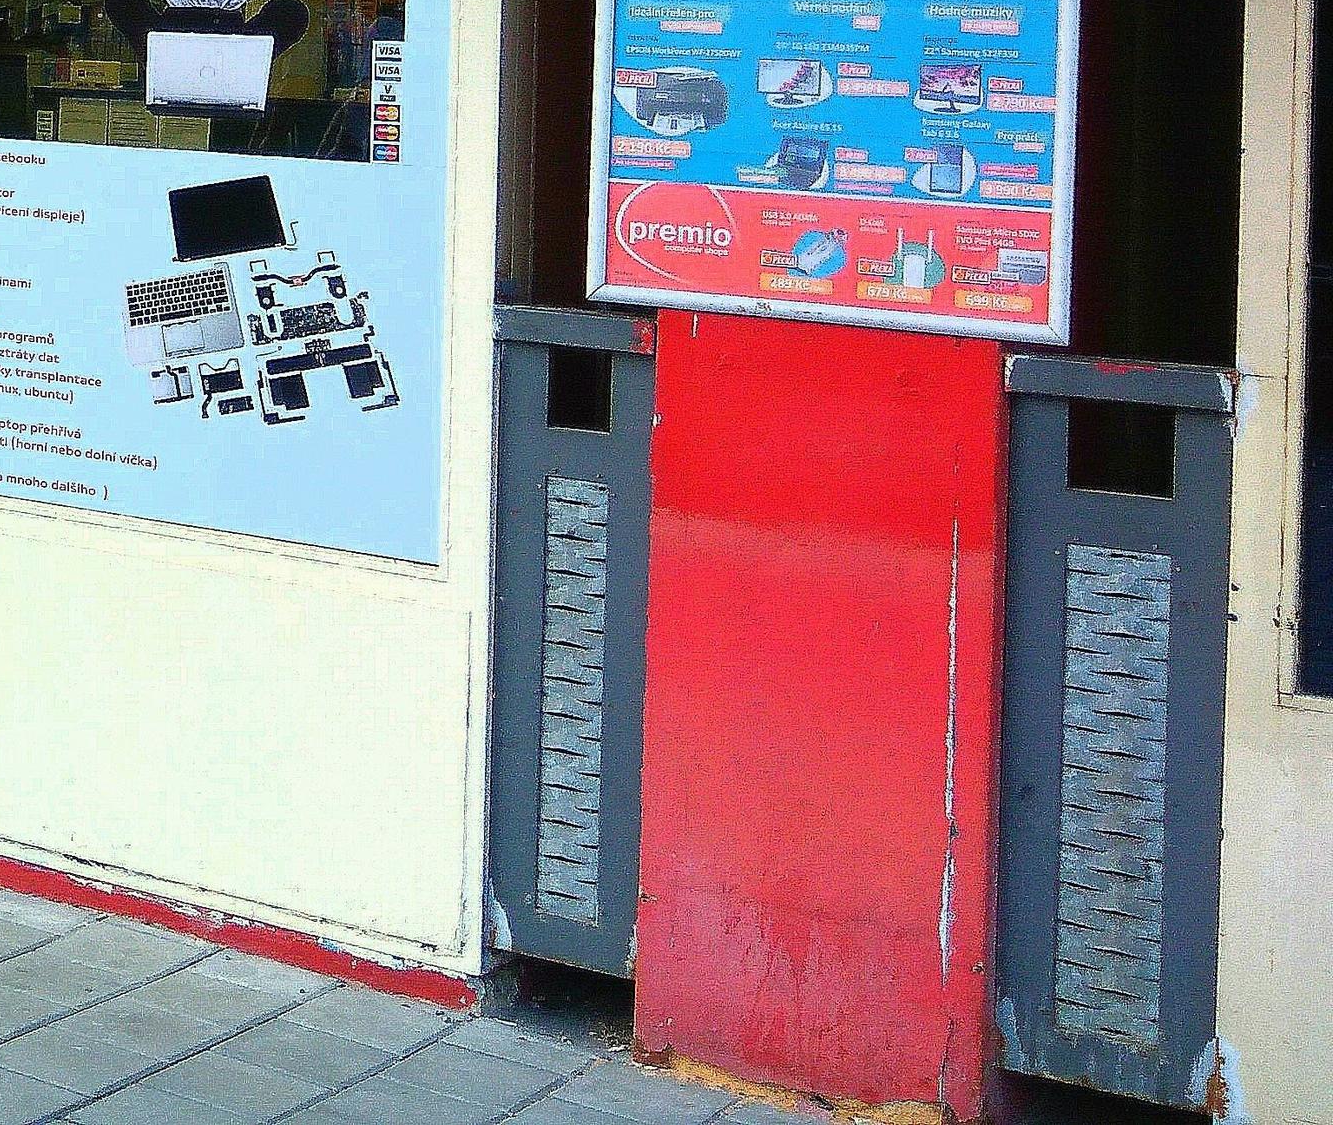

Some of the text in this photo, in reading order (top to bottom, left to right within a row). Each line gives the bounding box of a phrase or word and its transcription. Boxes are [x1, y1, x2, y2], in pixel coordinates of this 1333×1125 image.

[378, 46, 400, 56] VISA
[378, 65, 400, 75] VISA
[32, 207, 85, 225] displeje)
[630, 220, 733, 248] premio
[6, 475, 48, 489] mnoho
